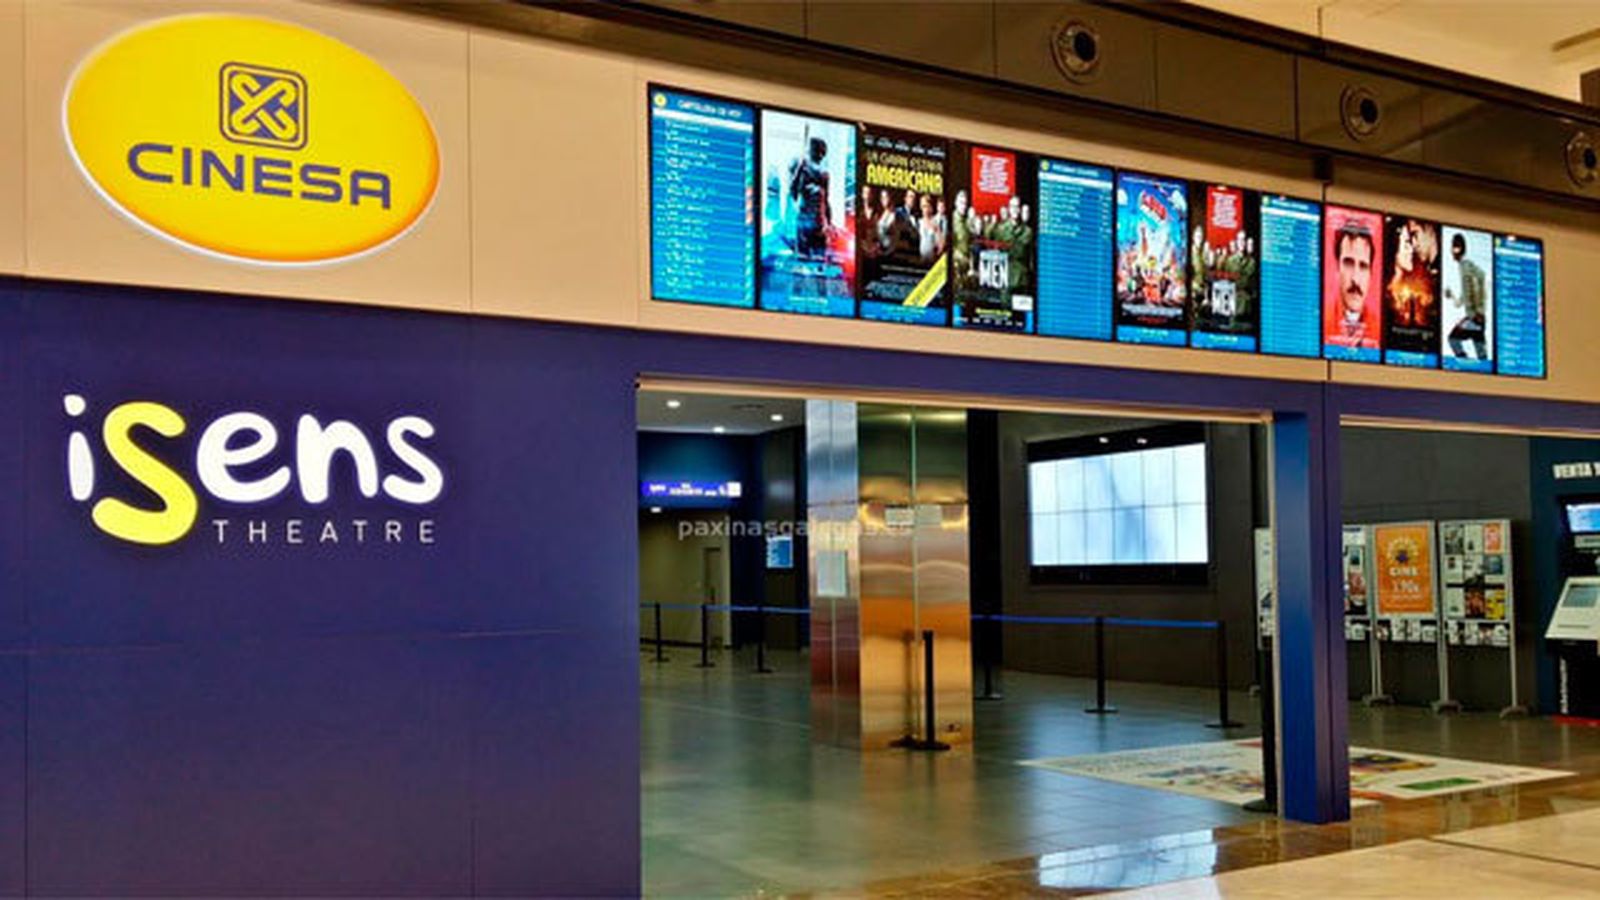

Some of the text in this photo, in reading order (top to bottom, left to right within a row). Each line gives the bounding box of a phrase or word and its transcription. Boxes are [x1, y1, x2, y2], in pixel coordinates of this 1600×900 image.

[127, 142, 391, 210] CINESA
[866, 162, 944, 195] AMERICANA
[979, 257, 1009, 289] MEN
[64, 394, 444, 545] iSens
[212, 519, 435, 545] THEATRE
